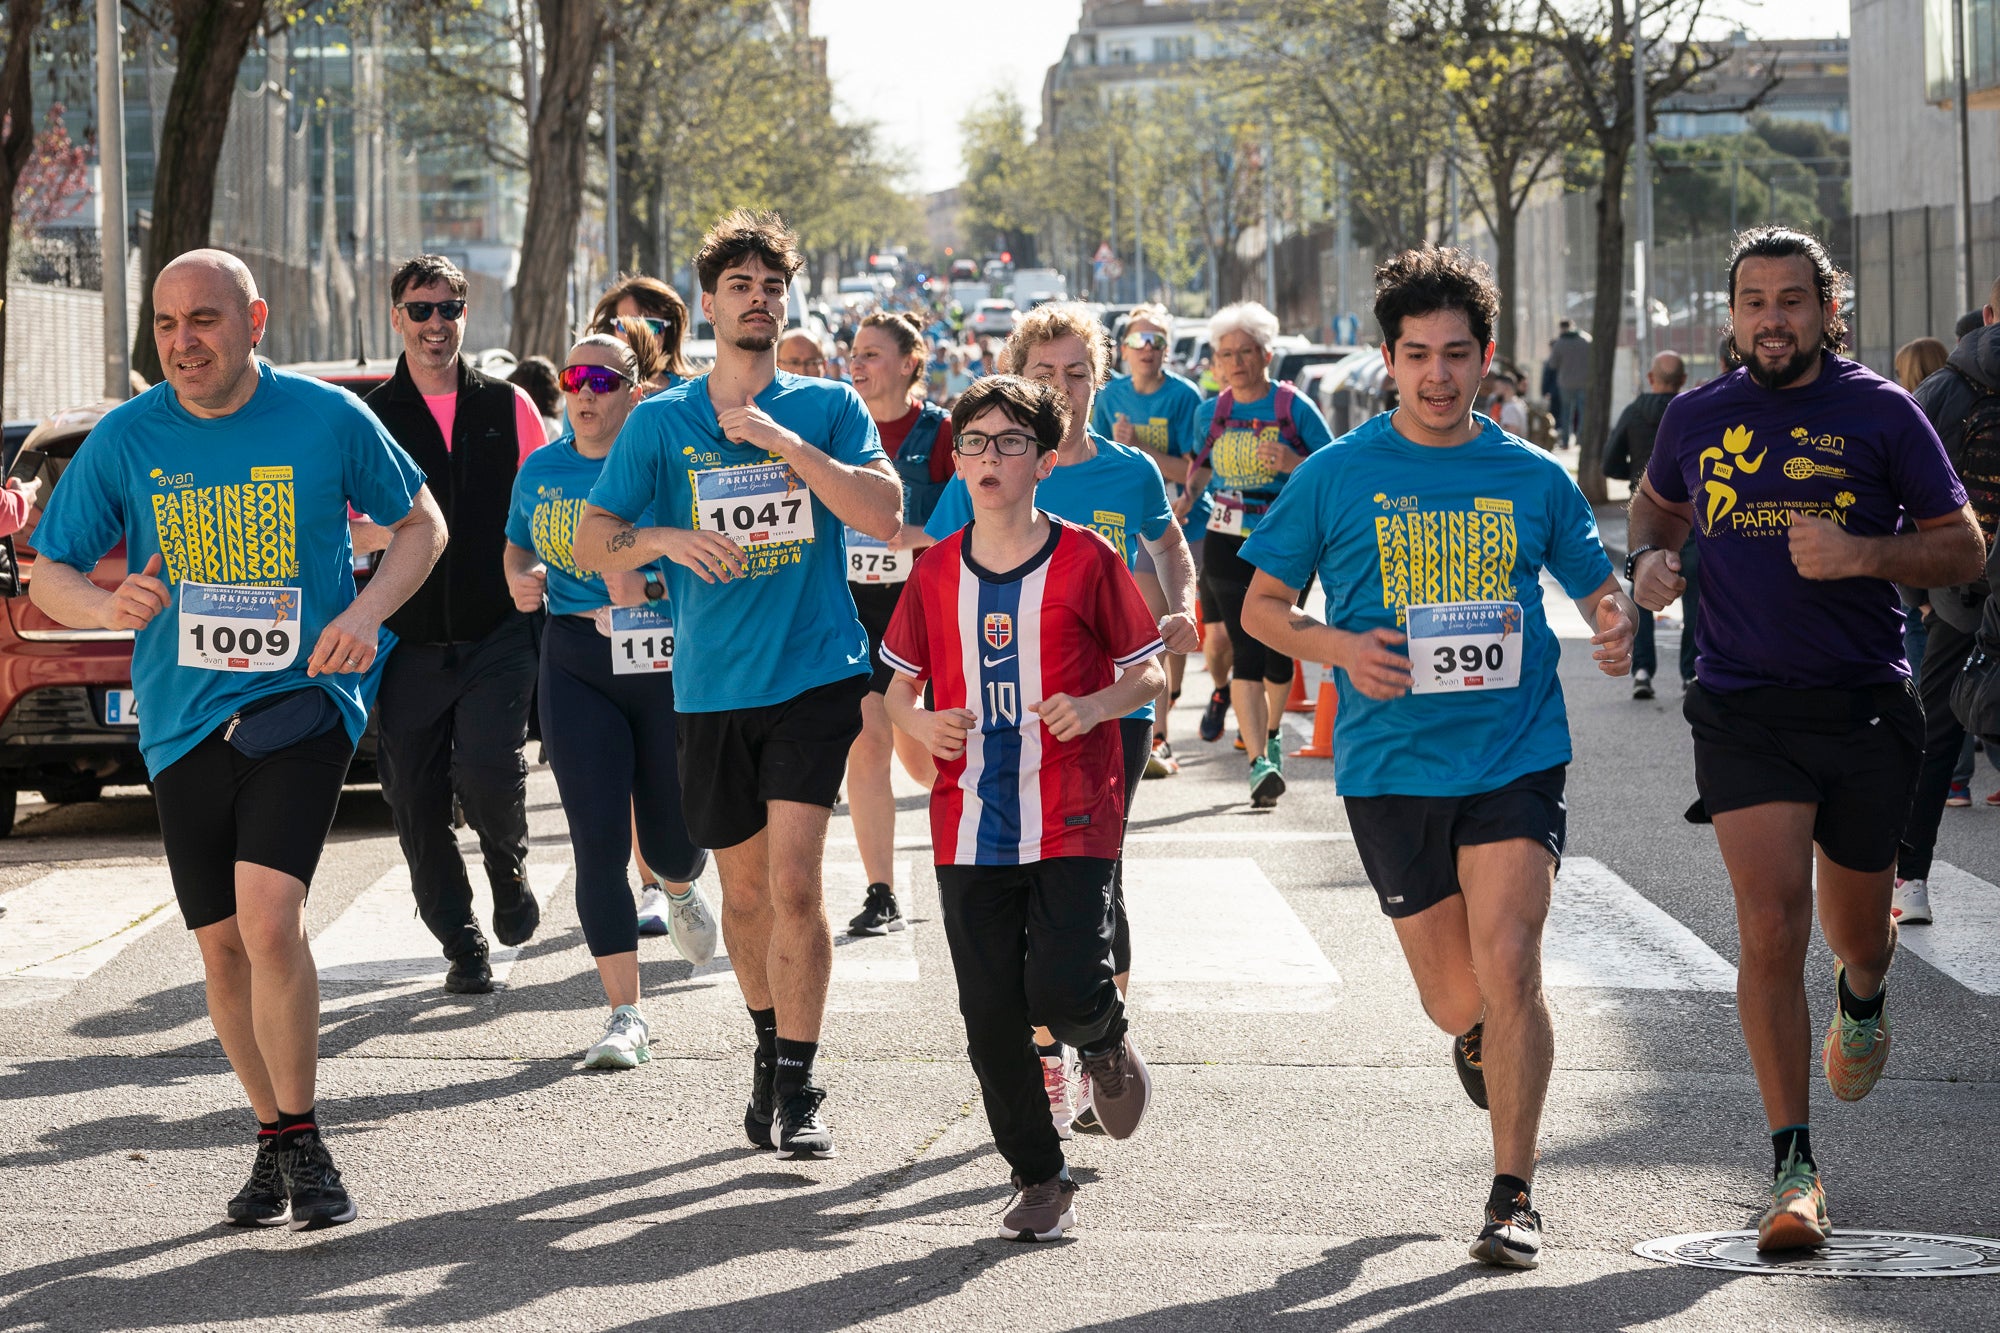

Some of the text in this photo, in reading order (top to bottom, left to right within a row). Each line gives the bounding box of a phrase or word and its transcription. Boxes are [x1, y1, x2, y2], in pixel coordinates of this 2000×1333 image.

[1798, 434, 1844, 449] avan
[690, 452, 721, 463] avan
[158, 472, 194, 486] avan
[718, 471, 786, 485] PARKINSON
[152, 482, 294, 511] PARKINSON
[1382, 496, 1418, 510] avan
[711, 499, 802, 532] 1047
[1375, 511, 1514, 532] PARKINSON
[1742, 529, 1782, 537] LEONOR
[852, 554, 897, 572] 875
[203, 593, 277, 604] PARKINSON
[1432, 611, 1503, 622] PARKINSON
[190, 624, 289, 656] 1009
[622, 636, 675, 659] 118
[1434, 643, 1503, 674] 390
[986, 682, 1017, 727] 10
